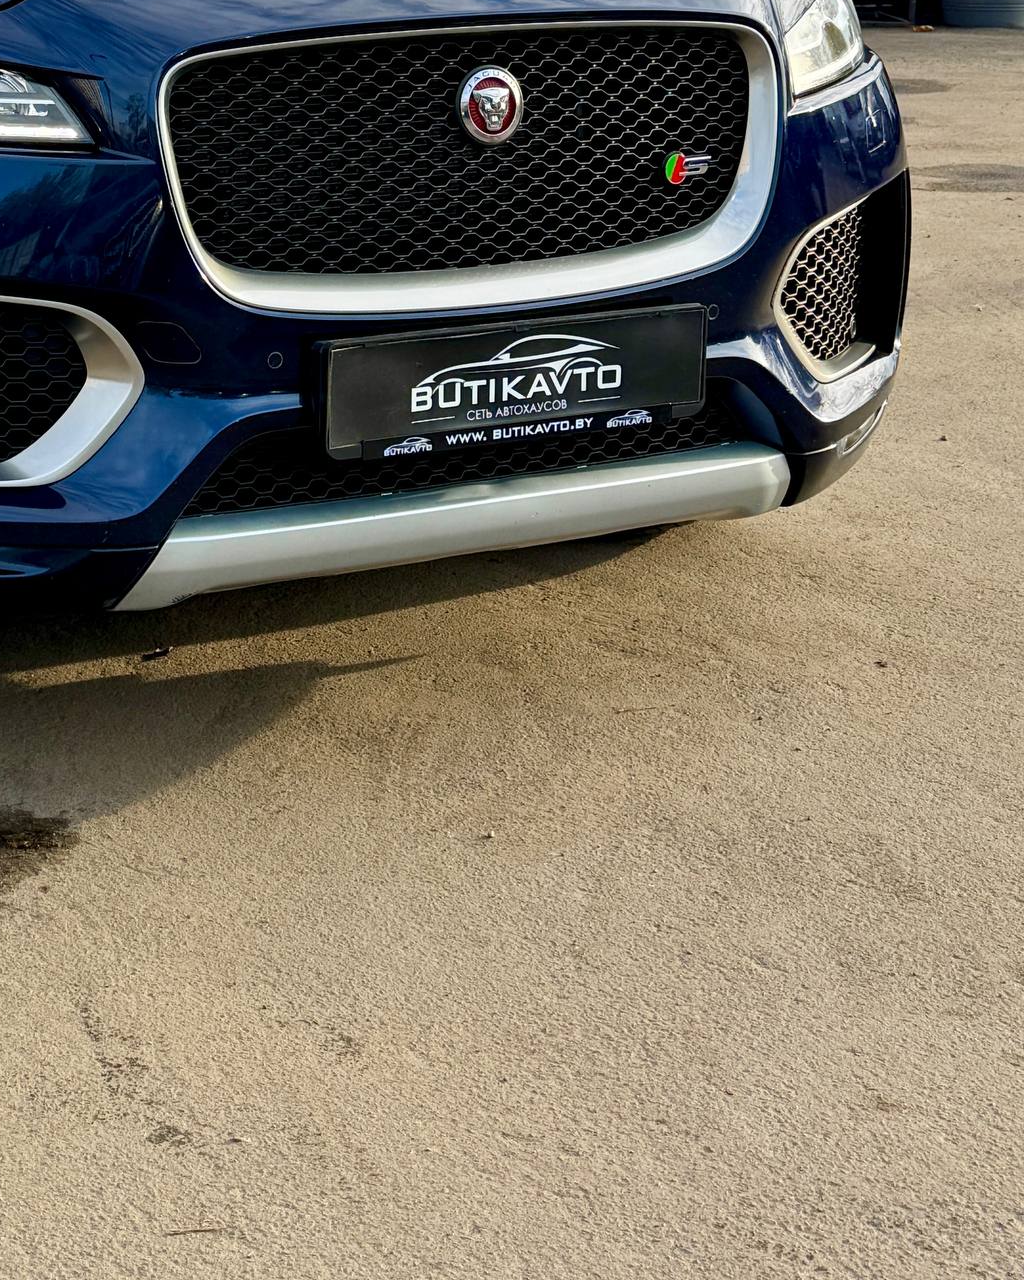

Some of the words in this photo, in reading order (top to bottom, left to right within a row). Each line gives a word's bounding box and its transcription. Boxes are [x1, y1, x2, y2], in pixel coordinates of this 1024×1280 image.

[411, 364, 622, 413] BUTIKAVTO
[466, 409, 493, 421] СЕТЬ
[495, 399, 568, 418] АВТОХАУСОВ
[445, 430, 487, 445] WWW.
[492, 417, 594, 440] BUTIKAVTO.BY
[606, 416, 653, 428] BUTIKAVTO
[383, 444, 433, 457] BUTIKAVTO
